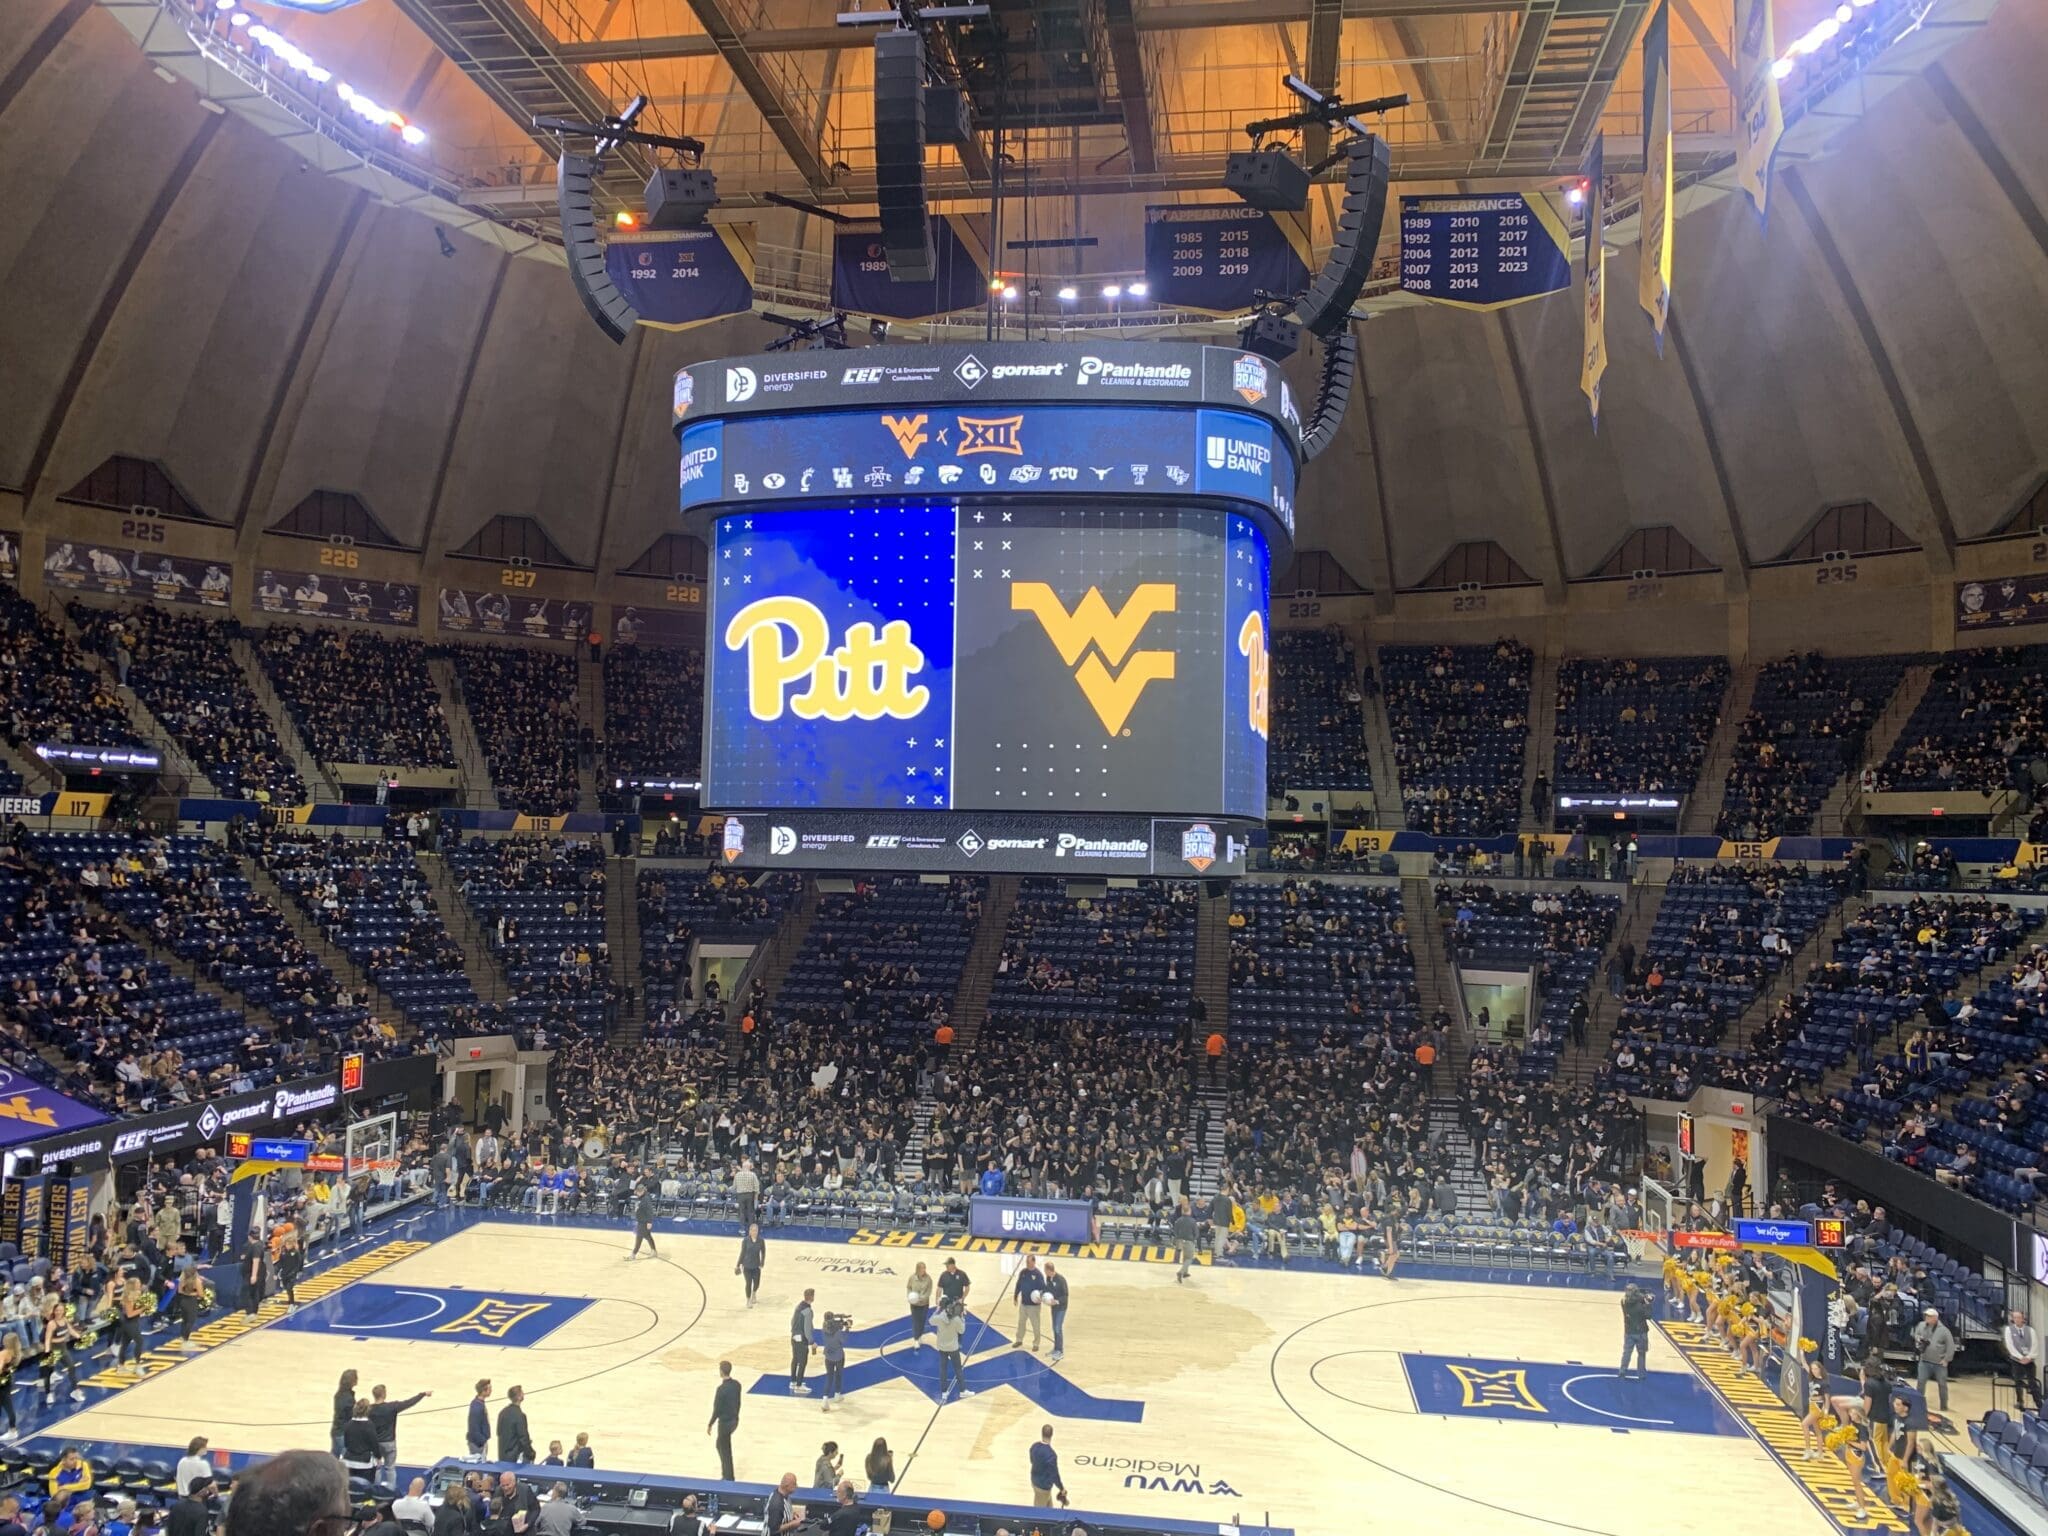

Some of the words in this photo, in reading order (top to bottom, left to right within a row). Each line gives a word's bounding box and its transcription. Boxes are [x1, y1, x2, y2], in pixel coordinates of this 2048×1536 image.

[1424, 199, 1522, 212] APPEARANCES
[1404, 219, 1431, 229] 1989
[1450, 217, 1479, 228] 2010
[1498, 216, 1528, 226] 2016
[1174, 232, 1203, 243] 1985
[1220, 231, 1249, 241] 2015
[1404, 234, 1430, 244] 1992
[1450, 232, 1478, 243] 2011
[1498, 231, 1528, 242] 2017
[1173, 249, 1203, 260] 2005
[1219, 247, 1249, 258] 2018
[1403, 249, 1431, 259] 2004
[1450, 248, 1479, 259] 2012
[1498, 246, 1528, 257] 2021
[860, 261, 887, 271] 1989
[1172, 266, 1203, 276] 2009
[1219, 264, 1249, 275] 2019
[1404, 264, 1431, 274] 2007
[1450, 263, 1479, 274] 2013
[1498, 261, 1528, 272] 2023
[631, 269, 656, 279] 1992
[672, 268, 699, 278] 2014
[1403, 279, 1431, 290] 2008
[1450, 278, 1479, 289] 2014
[763, 370, 827, 382] DIVERSIFIED
[841, 367, 885, 385] CEC
[992, 363, 1064, 378] gomart
[1102, 363, 1191, 379] Panhandle
[763, 381, 794, 392] energy
[1100, 377, 1135, 386] CLEANING
[1136, 378, 1142, 386] &
[1143, 378, 1190, 387] RESTORATION
[1235, 374, 1267, 393] BRAWL
[1228, 438, 1271, 463] UNITED
[1227, 456, 1263, 476] BANK
[1049, 466, 1078, 481] TCU
[122, 520, 165, 543] 225
[320, 548, 359, 569] 226
[502, 569, 536, 588] 227
[1817, 564, 1857, 585] 235
[666, 584, 700, 603] 228
[1289, 603, 1320, 618] 232
[725, 595, 930, 722] Pitt
[71, 801, 90, 816] 117
[531, 818, 550, 831] 119
[802, 834, 855, 843] DIVERSIFIED
[865, 835, 901, 849] CEC
[987, 838, 1045, 850] gomart
[1076, 839, 1148, 851] Panhandle
[1355, 837, 1379, 851] 123
[802, 842, 827, 850] energy
[1734, 844, 1762, 858] 125
[344, 1068, 357, 1088] 30
[287, 1084, 335, 1107] Panhandle
[222, 1101, 268, 1125] gomart
[111, 1129, 148, 1155] CEC
[42, 1141, 102, 1164] DIVERSIFIED
[231, 1144, 245, 1155] 30
[1015, 1210, 1057, 1222] UNITED
[1015, 1221, 1046, 1232] BANK
[1766, 1226, 1791, 1240] Kroger
[1822, 1231, 1838, 1243] 30
[795, 1255, 880, 1268] Medicine
[821, 1264, 875, 1275] WVU
[1074, 1455, 1200, 1478] Medicine
[1124, 1474, 1204, 1494] WVU
